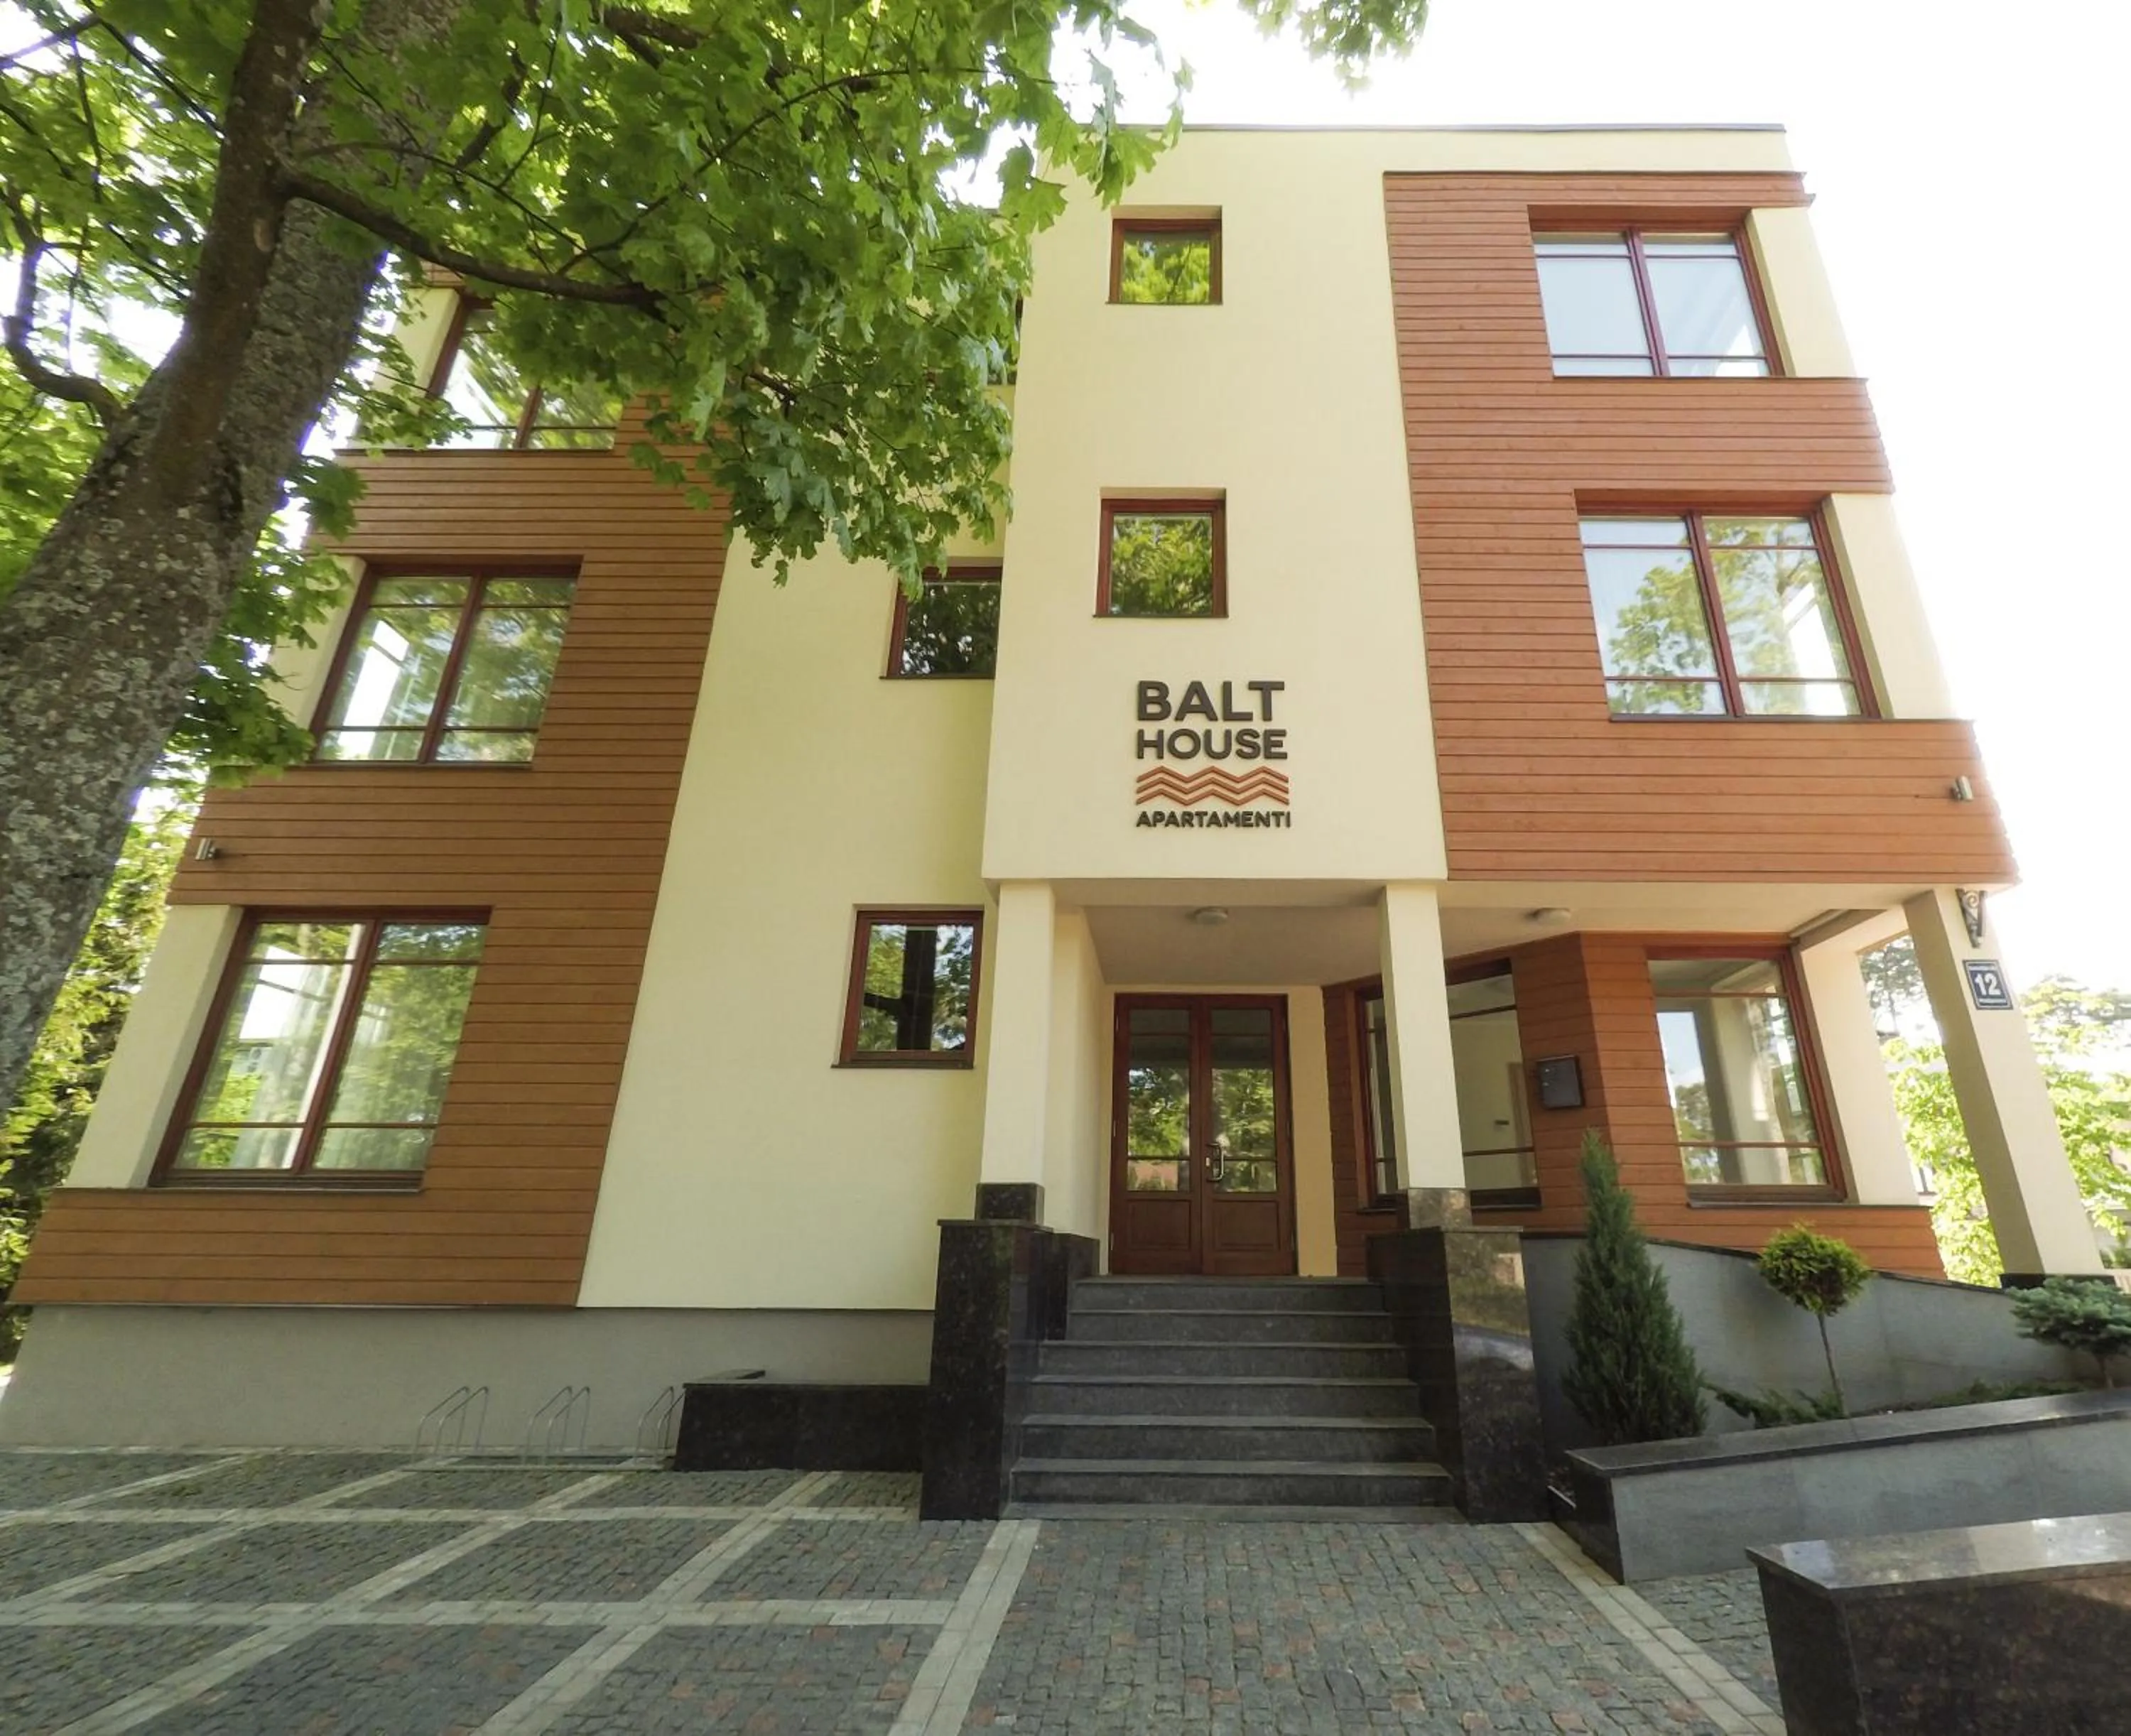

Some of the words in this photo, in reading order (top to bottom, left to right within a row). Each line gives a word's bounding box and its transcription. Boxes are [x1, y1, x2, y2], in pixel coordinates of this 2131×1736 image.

[1137, 680, 1285, 722] BALT
[1137, 728, 1288, 759] HOUSE
[1136, 810, 1291, 828] APARTAMENTI
[1975, 973, 2001, 996] 12
